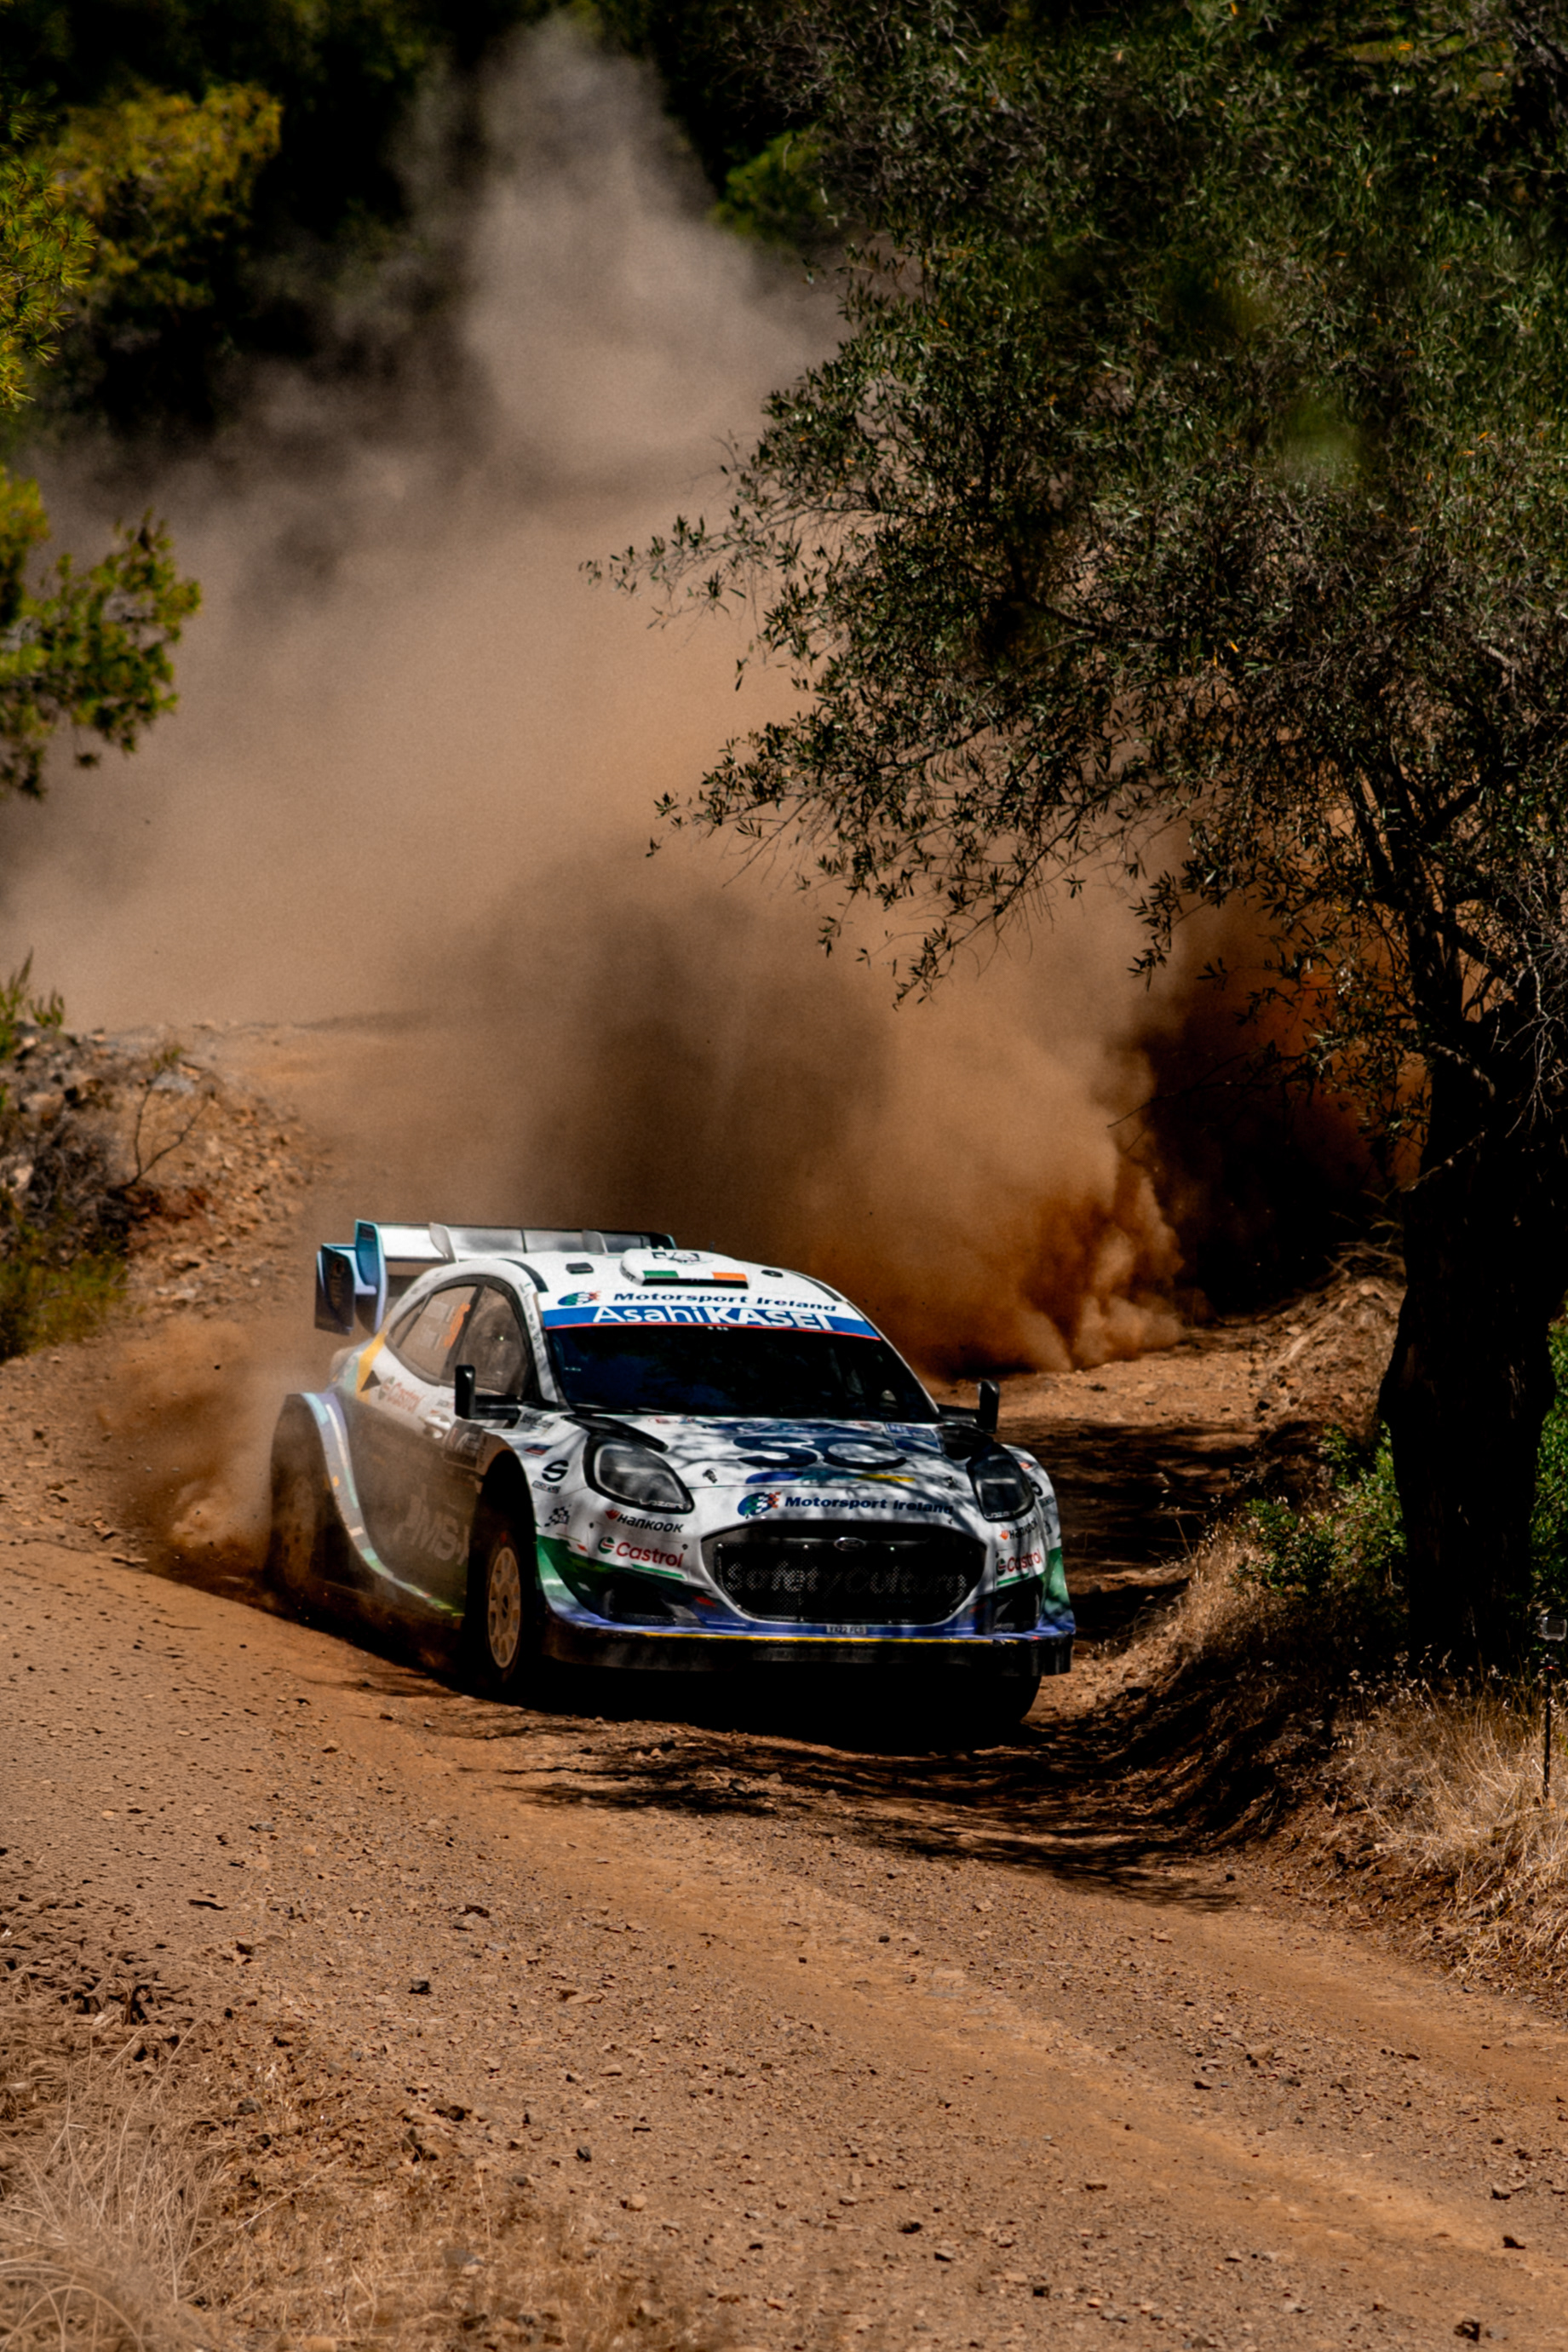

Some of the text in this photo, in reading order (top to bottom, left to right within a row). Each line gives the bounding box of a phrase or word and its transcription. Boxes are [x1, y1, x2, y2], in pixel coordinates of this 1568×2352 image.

[613, 1291, 837, 1312] Motorsport Ireland
[732, 1435, 907, 1470] SC
[784, 1495, 954, 1515] Motorsport Ireland
[616, 1542, 684, 1567] Castrol
